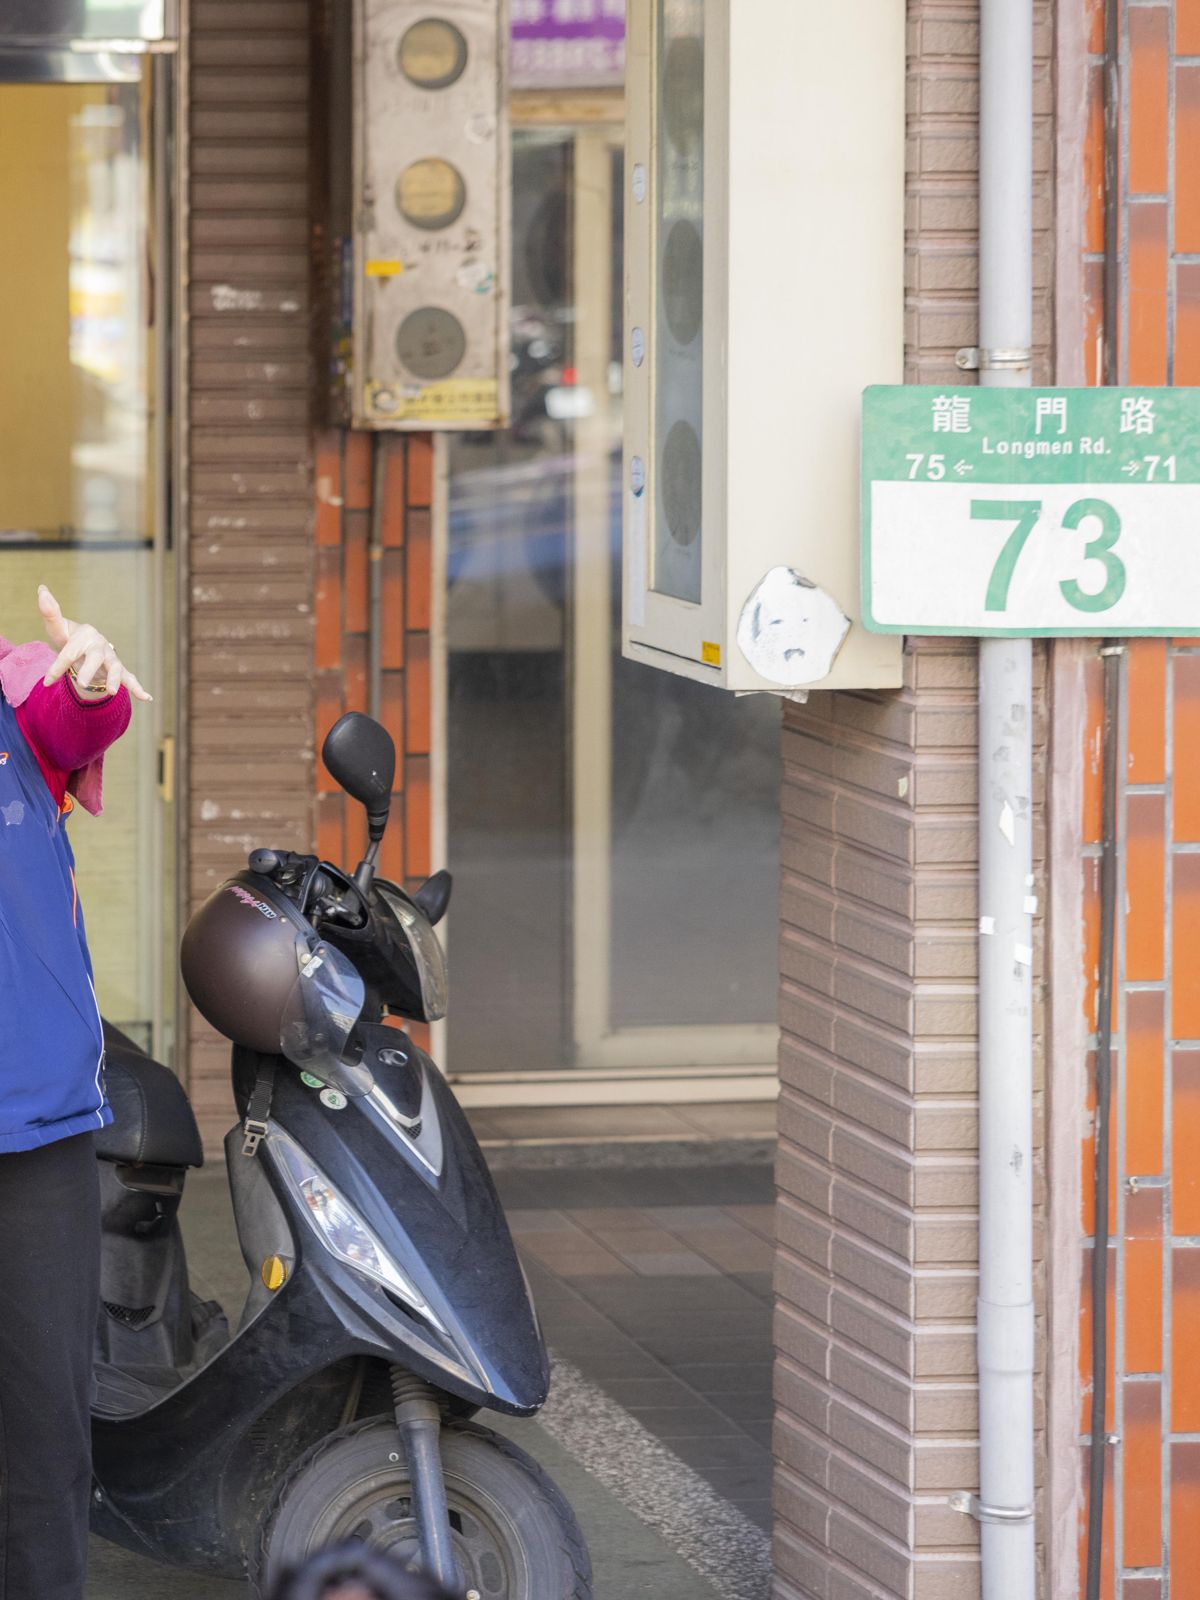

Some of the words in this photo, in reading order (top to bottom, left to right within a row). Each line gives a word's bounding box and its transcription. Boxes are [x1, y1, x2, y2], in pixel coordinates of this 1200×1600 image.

[932, 395, 1156, 434] 龍門路
[983, 437, 1072, 459] Longmen
[1080, 437, 1111, 455] Rd.
[906, 454, 946, 480] 75
[1145, 456, 1177, 481] 71
[970, 498, 1127, 613] 73
